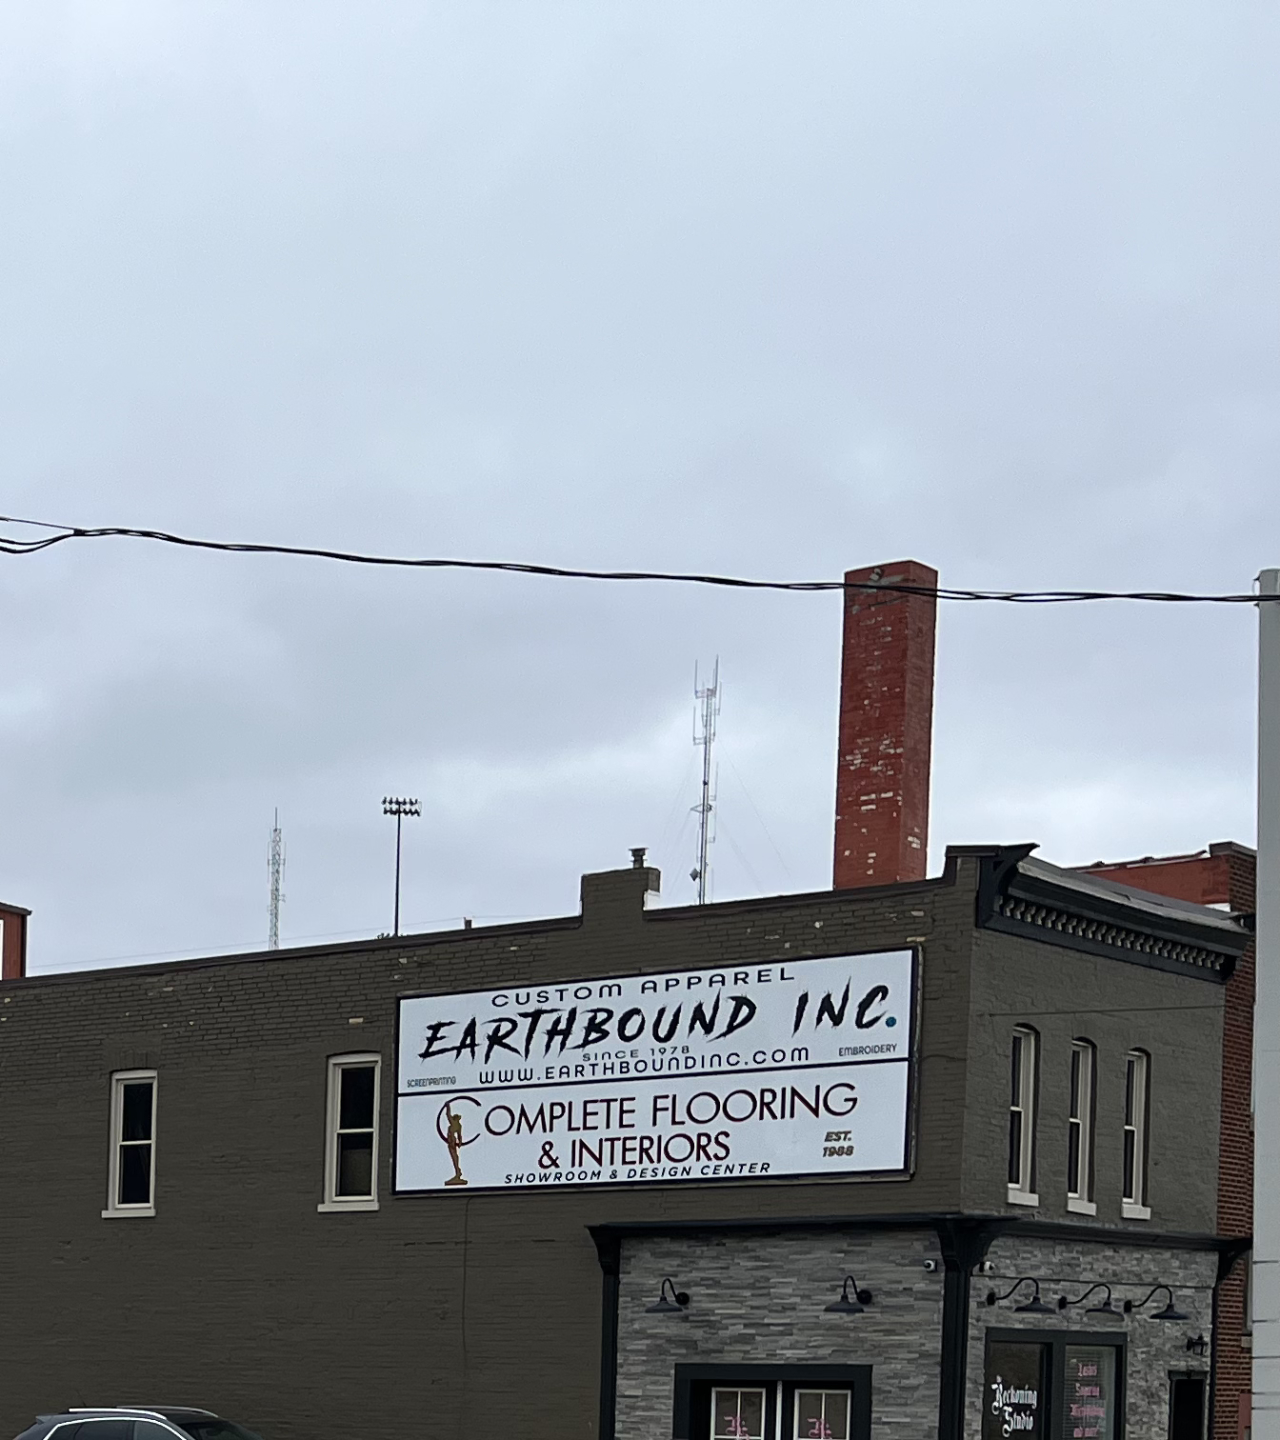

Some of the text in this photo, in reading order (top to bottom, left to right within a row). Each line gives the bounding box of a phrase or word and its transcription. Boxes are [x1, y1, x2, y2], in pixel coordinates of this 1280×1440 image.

[491, 967, 795, 1008] CUSTOM APPAREL
[418, 975, 897, 1065] EARTHBOUND INC.
[582, 1045, 690, 1062] SINCE 1978
[838, 1043, 897, 1057] EMBROIDERY
[407, 1076, 457, 1088] SCREENPRINTING
[436, 1082, 858, 1146] COMPLETE FLOORING
[538, 1131, 731, 1169] & INTERIORS
[824, 1130, 853, 1142] EST.
[504, 1162, 771, 1185] SHOWROOM & DESIGN CENTER
[991, 1375, 1037, 1415] Reckoning
[1002, 1405, 1034, 1437] Studio
